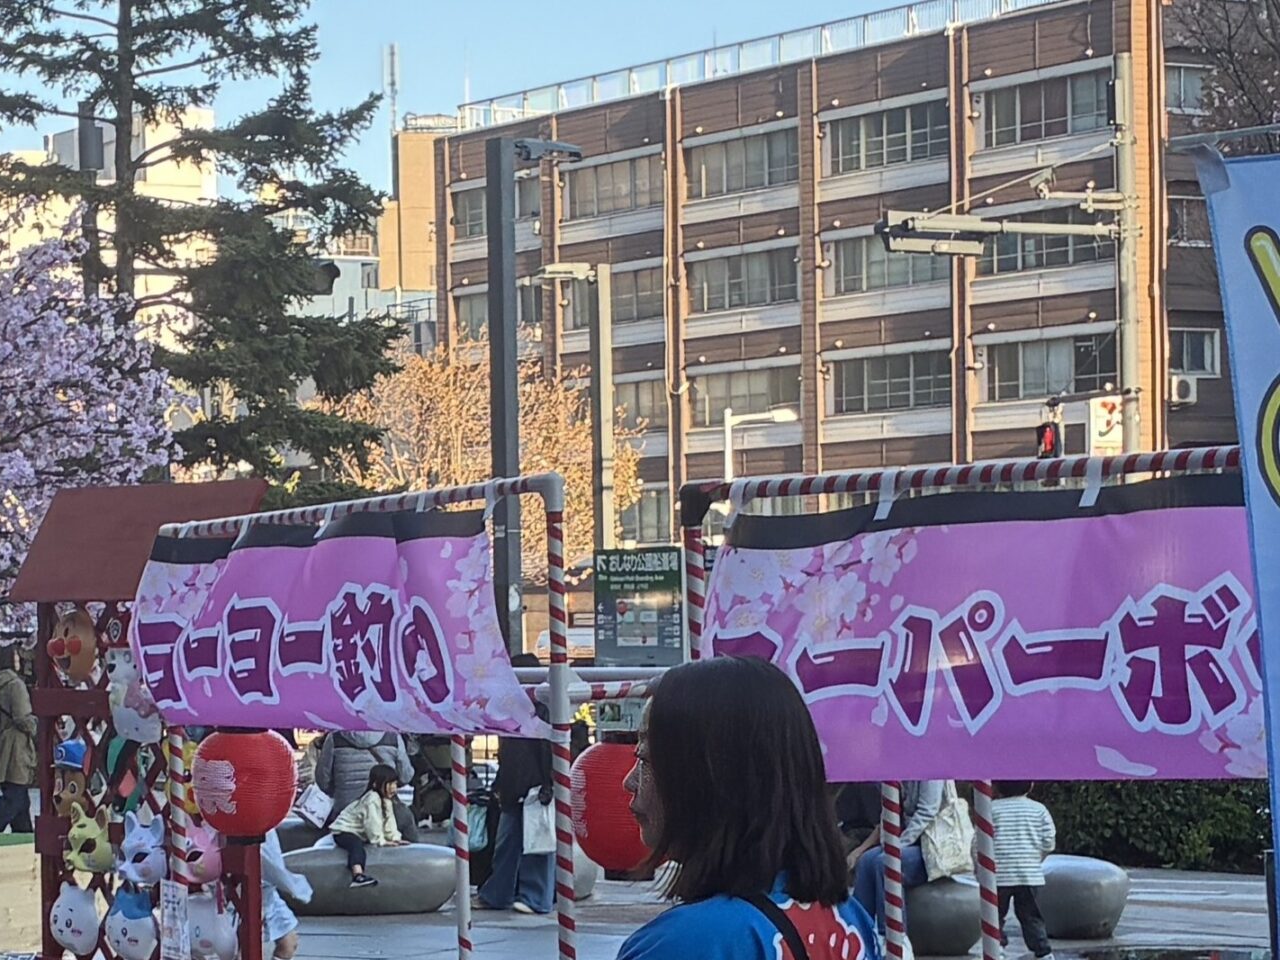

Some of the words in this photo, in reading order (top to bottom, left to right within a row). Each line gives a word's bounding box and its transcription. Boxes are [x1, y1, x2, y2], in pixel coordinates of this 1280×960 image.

[134, 582, 455, 711] ヨーヨー釣り
[710, 571, 1265, 737] ーパーボ
